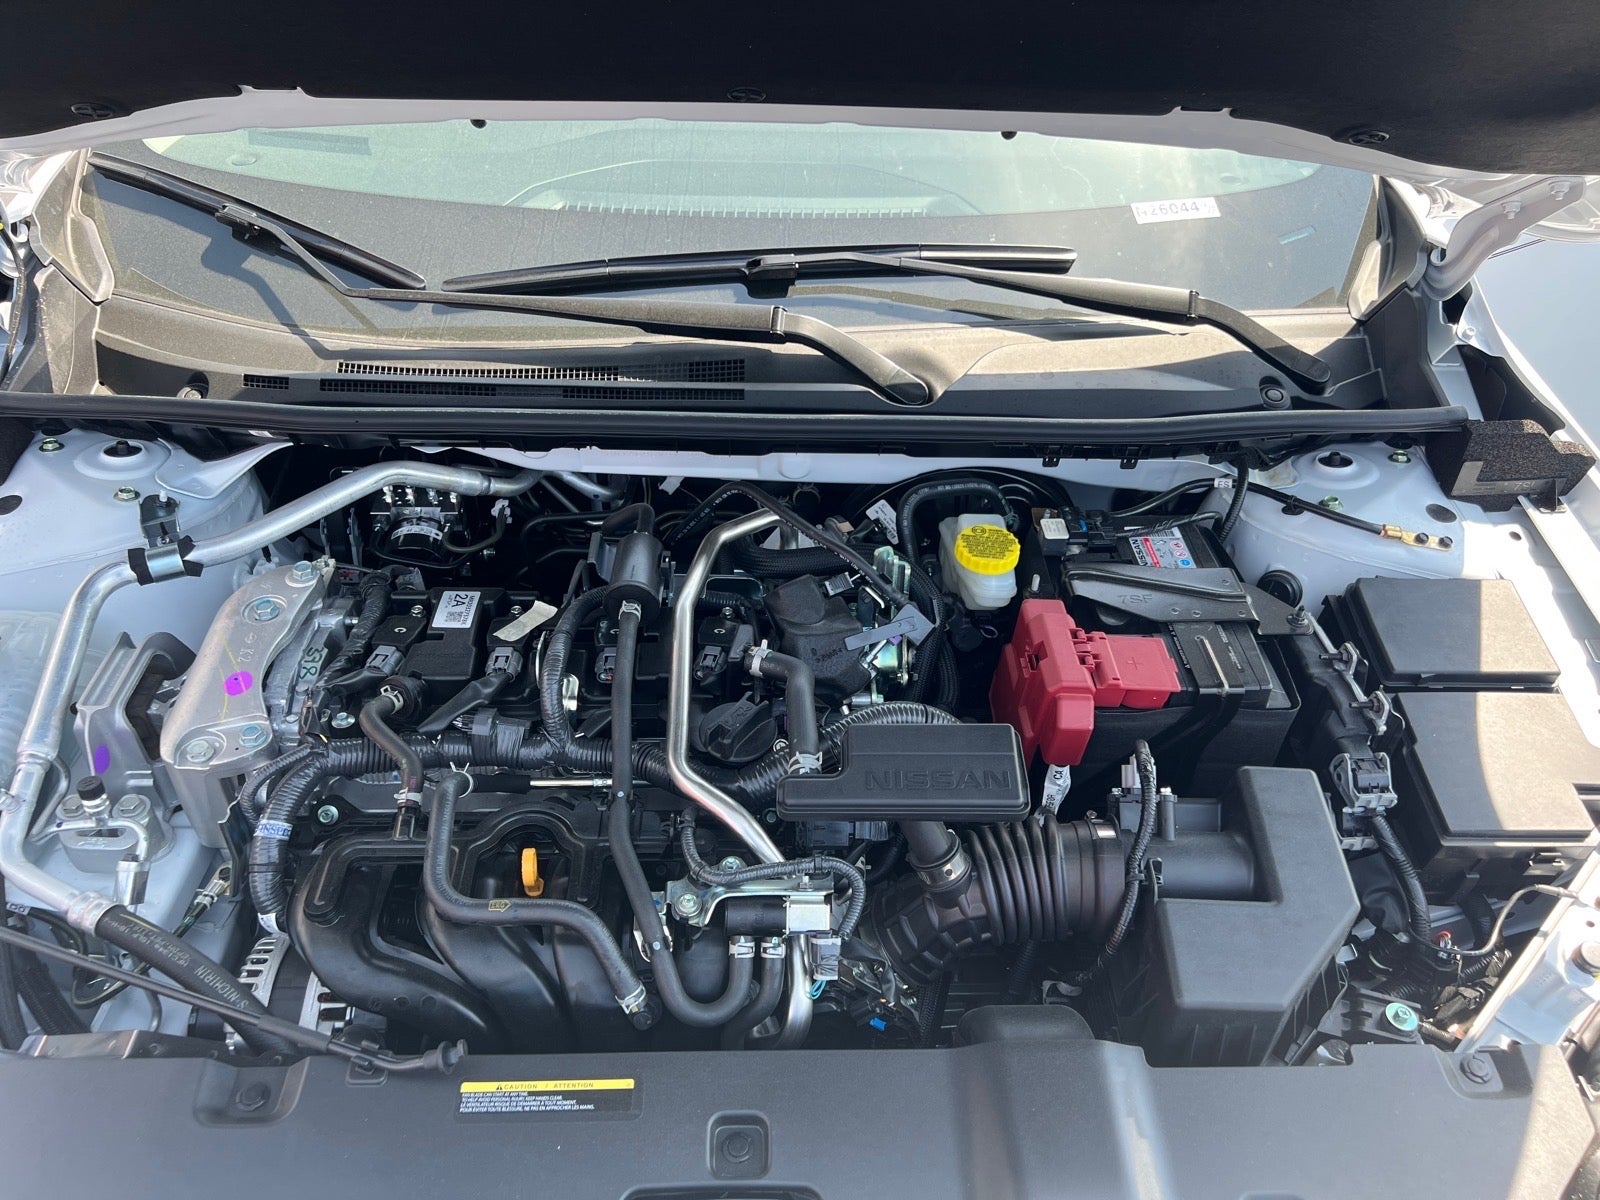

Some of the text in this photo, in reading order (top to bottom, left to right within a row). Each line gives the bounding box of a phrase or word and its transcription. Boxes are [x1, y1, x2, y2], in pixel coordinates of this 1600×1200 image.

[451, 593, 469, 608] 2A
[1117, 594, 1153, 604] 7SF
[865, 769, 1011, 791] NISSAN
